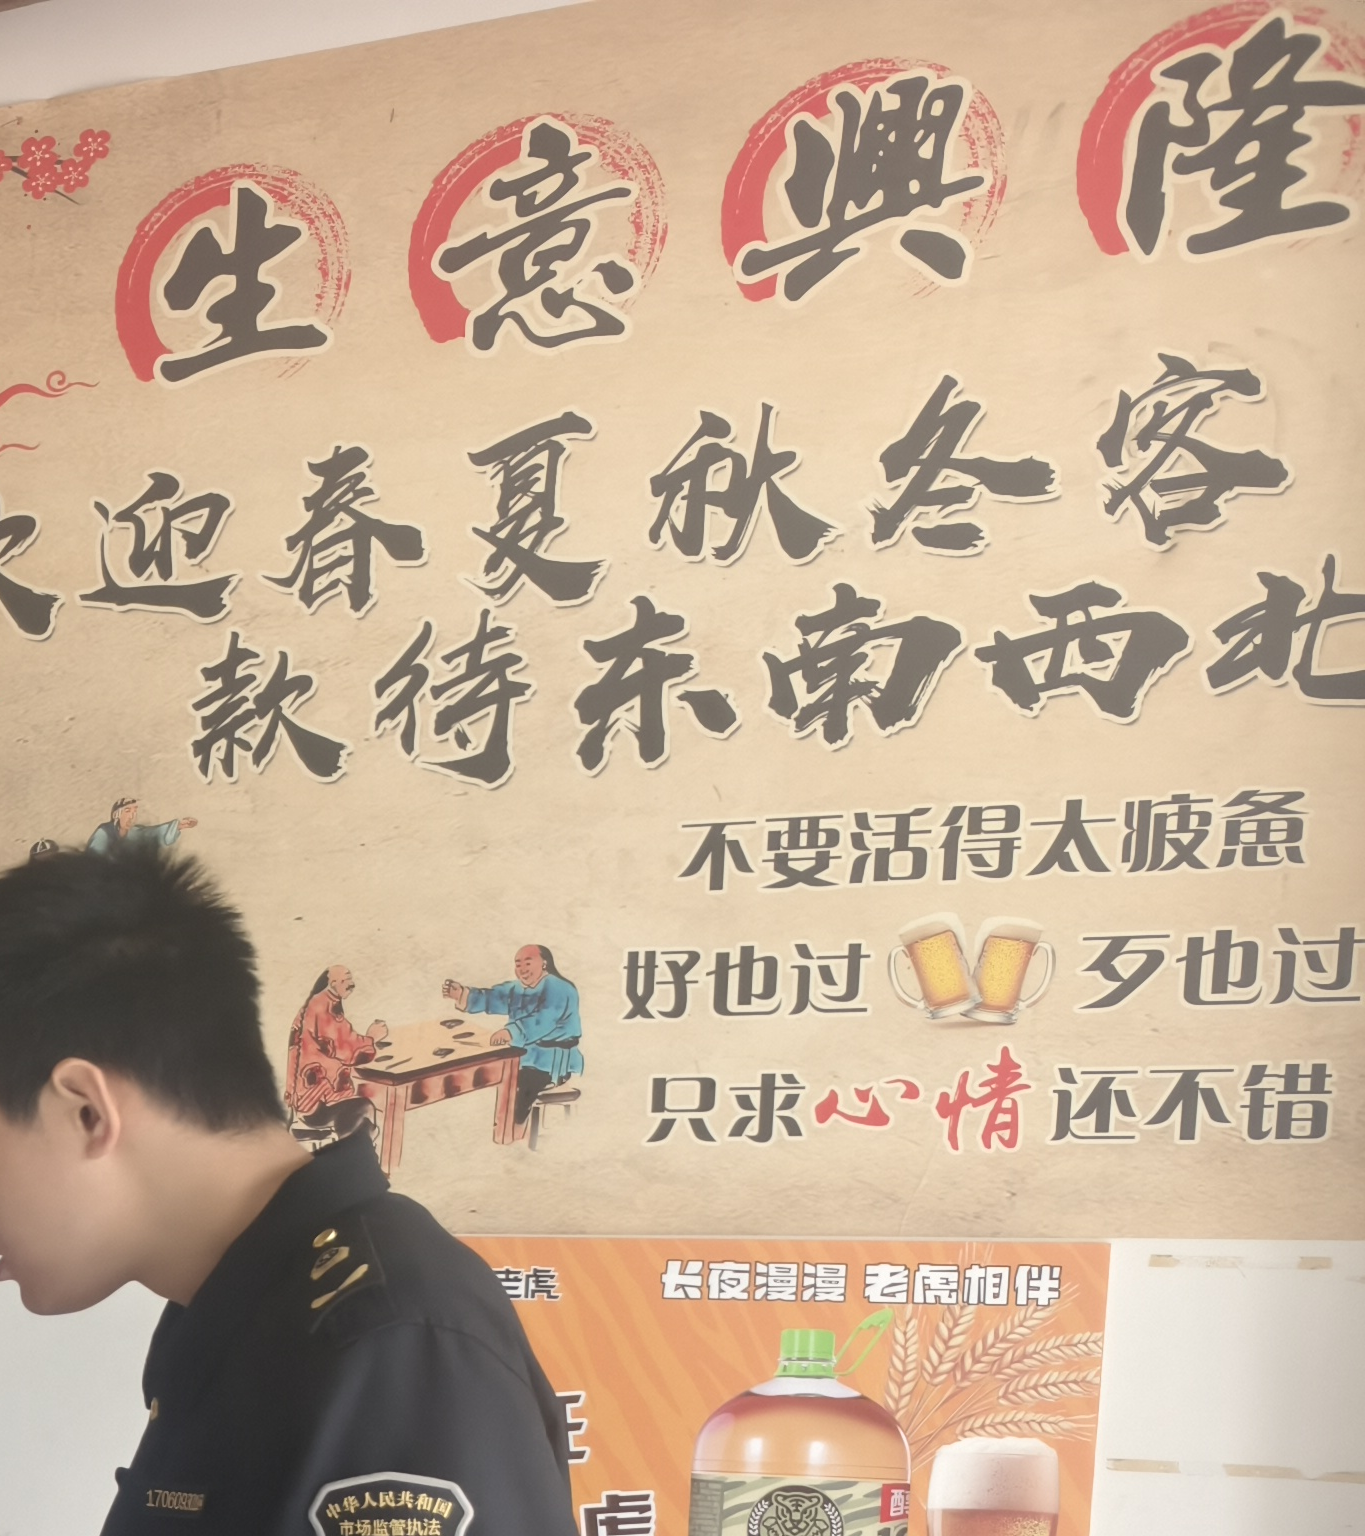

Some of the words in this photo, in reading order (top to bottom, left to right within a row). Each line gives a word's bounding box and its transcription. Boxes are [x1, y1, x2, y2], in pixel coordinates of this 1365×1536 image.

[190, 554, 1365, 787] 款待东南西北
[678, 790, 1311, 893] 不要活得太疲惫
[622, 943, 871, 1023] 好也过
[1079, 927, 1365, 1012] 歹也过
[645, 1044, 1336, 1153] 只求心情还不错
[660, 1258, 848, 1307] 长夜漫漫
[861, 1260, 1064, 1308] 老虎相伴
[325, 1490, 454, 1520] 中华人民共和国
[338, 1518, 442, 1536] 市场监管执法
